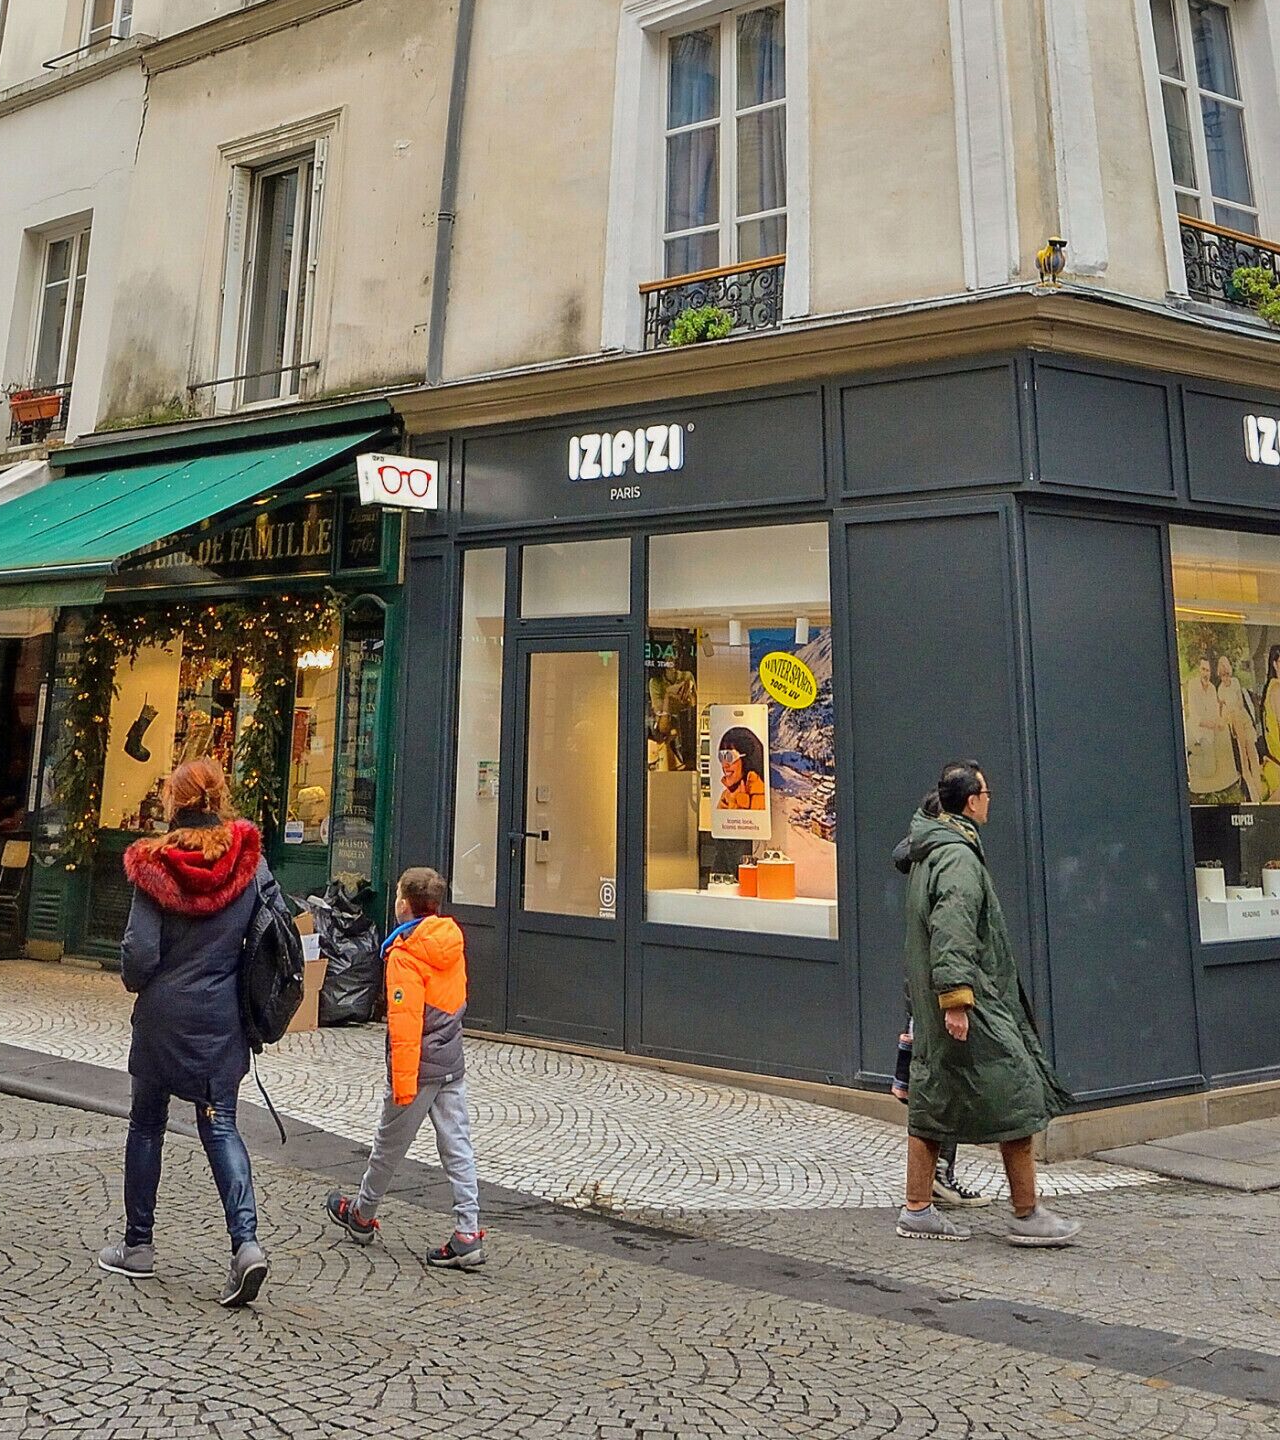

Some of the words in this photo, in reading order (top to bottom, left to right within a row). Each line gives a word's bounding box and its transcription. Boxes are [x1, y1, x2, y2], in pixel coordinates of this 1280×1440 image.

[568, 424, 684, 481] IZIPIZI
[610, 486, 641, 500] PARIS
[197, 534, 224, 565] DE
[229, 518, 333, 562] FAMILLE
[764, 658, 792, 684] WINTER
[790, 664, 814, 696] SPORTS
[788, 689, 801, 701] UV
[603, 887, 612, 902] B
